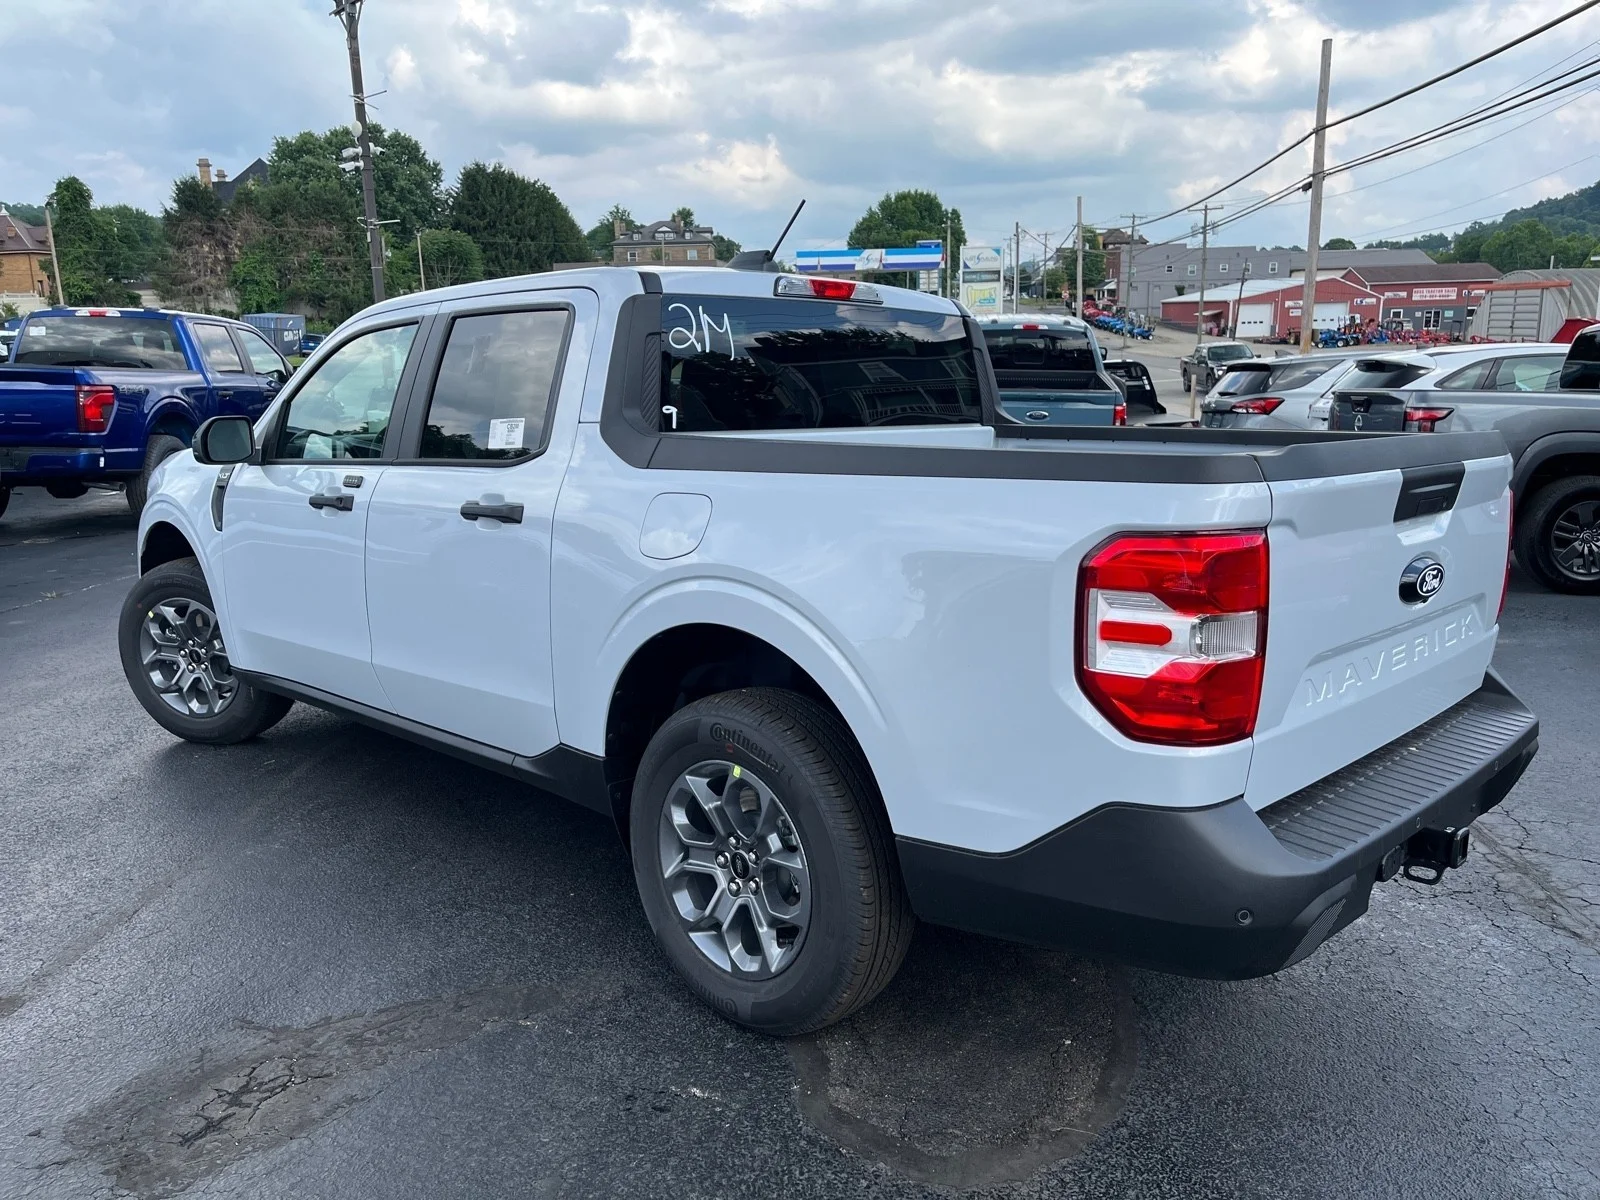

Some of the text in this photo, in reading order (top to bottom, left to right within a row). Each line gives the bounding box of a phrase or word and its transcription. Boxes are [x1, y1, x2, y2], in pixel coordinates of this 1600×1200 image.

[668, 303, 735, 361] 2M
[662, 405, 678, 429] 9
[1422, 569, 1441, 592] Ford
[1305, 614, 1473, 706] MAVERICK
[709, 722, 786, 775] Continental
